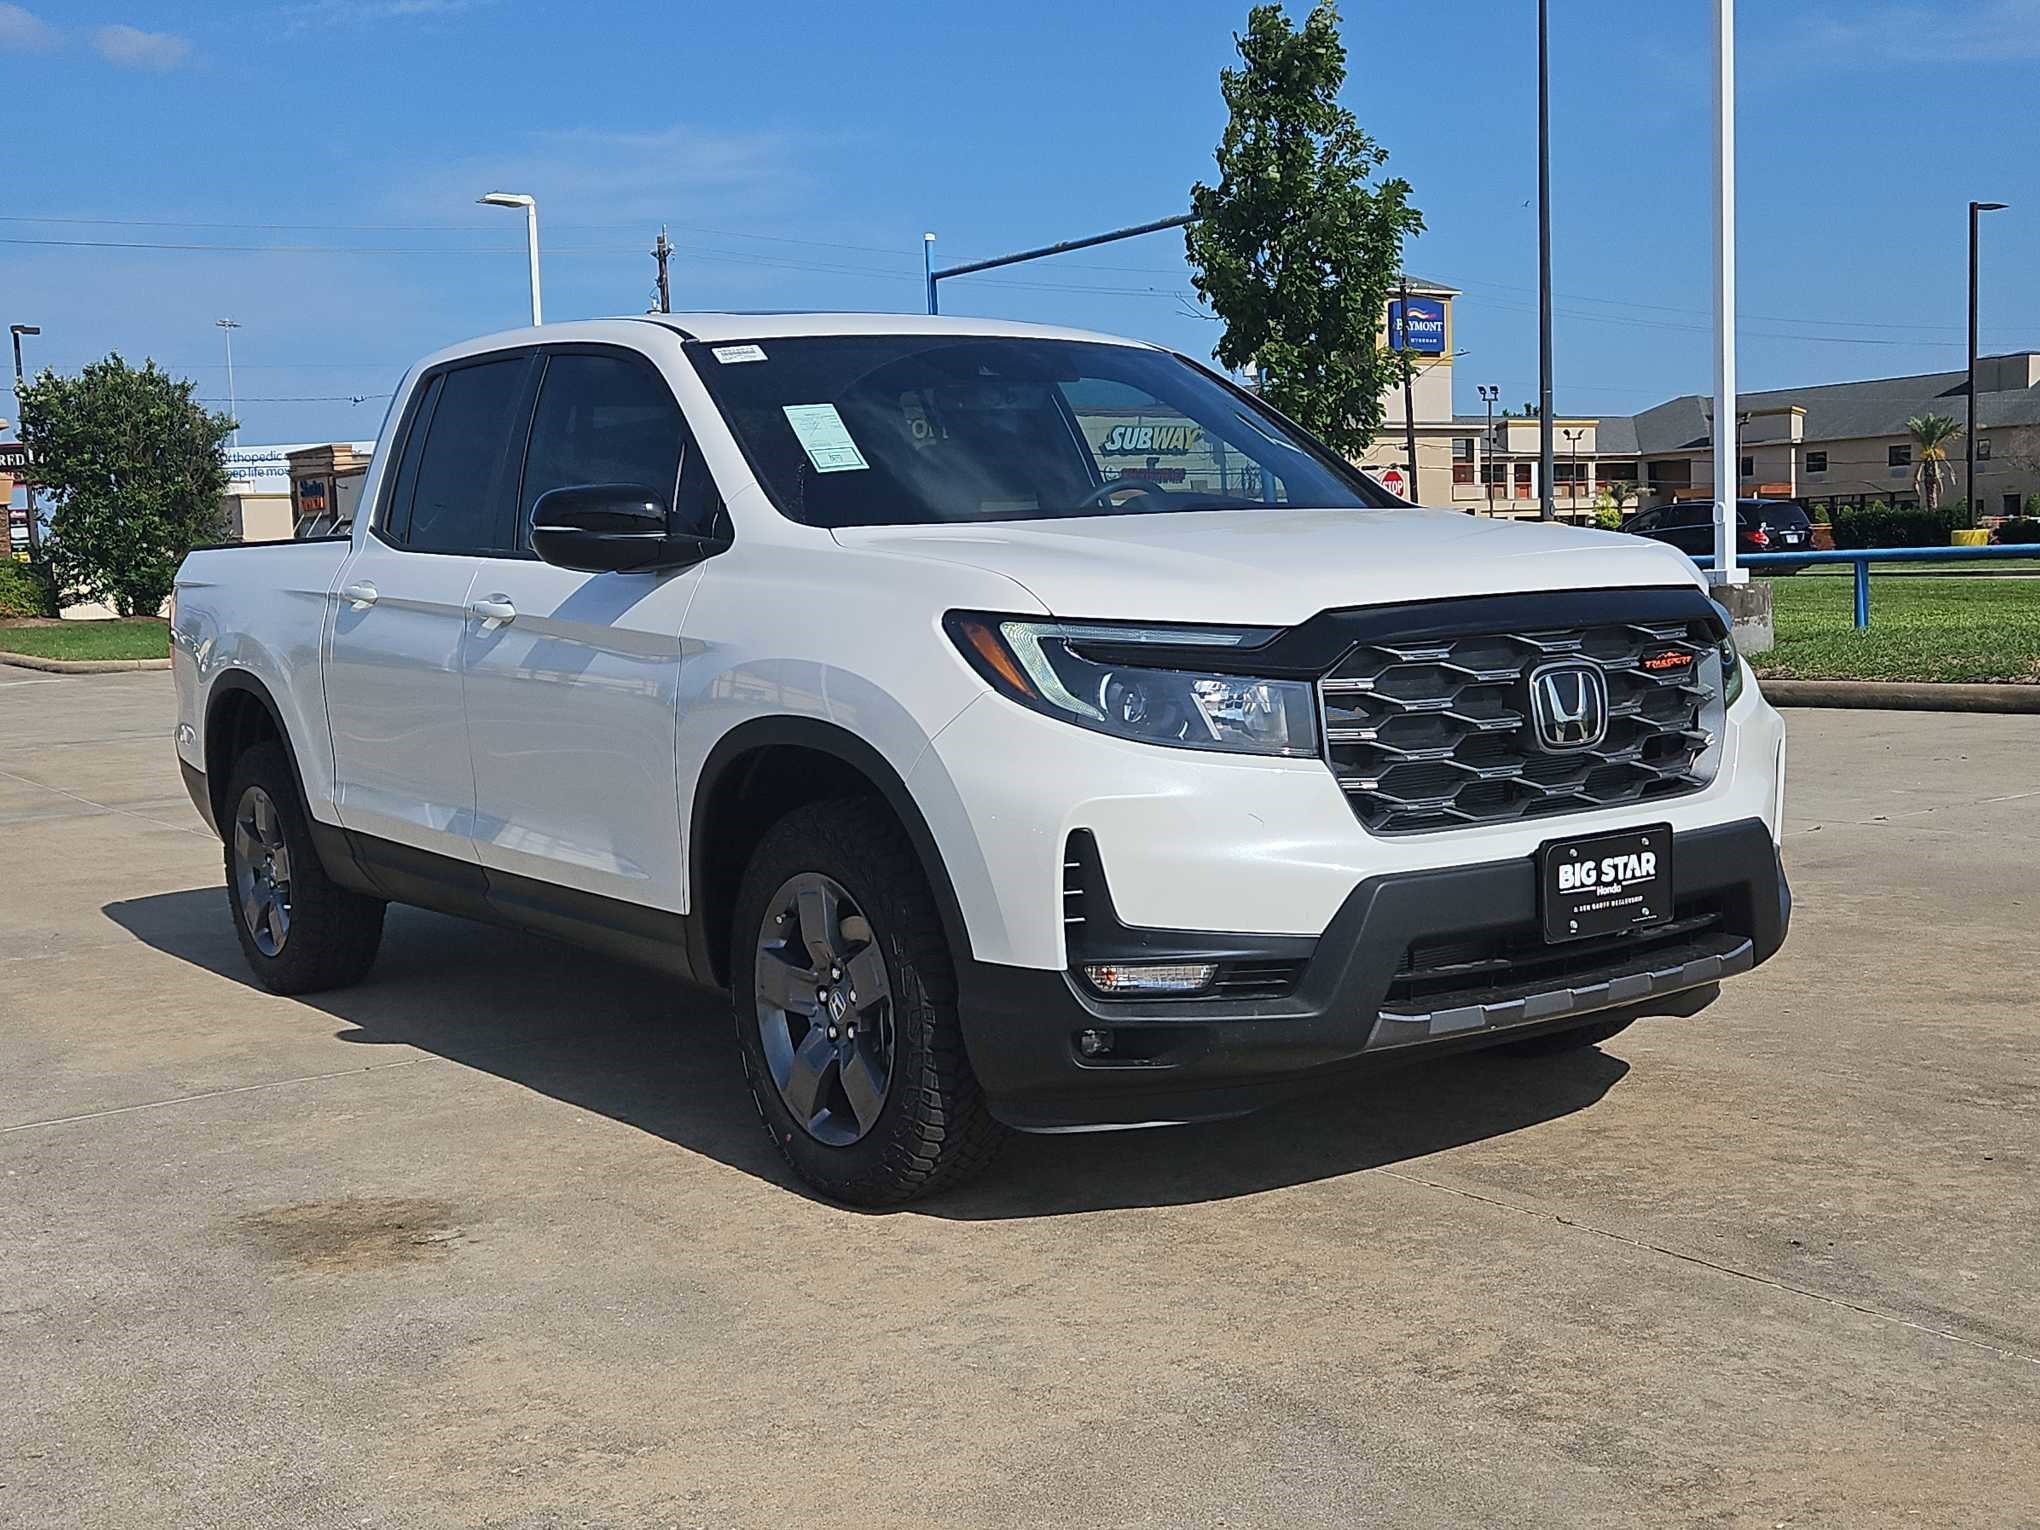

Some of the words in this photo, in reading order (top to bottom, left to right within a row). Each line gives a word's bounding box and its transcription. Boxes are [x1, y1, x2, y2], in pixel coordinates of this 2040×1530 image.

[1396, 318, 1443, 332] BYMONT
[1104, 425, 1204, 453] SUBWAY
[249, 467, 264, 478] life
[1382, 481, 1403, 494] STOP
[1559, 861, 1597, 889] BIG
[1601, 851, 1656, 882] STAR
[1596, 882, 1622, 896] Honda
